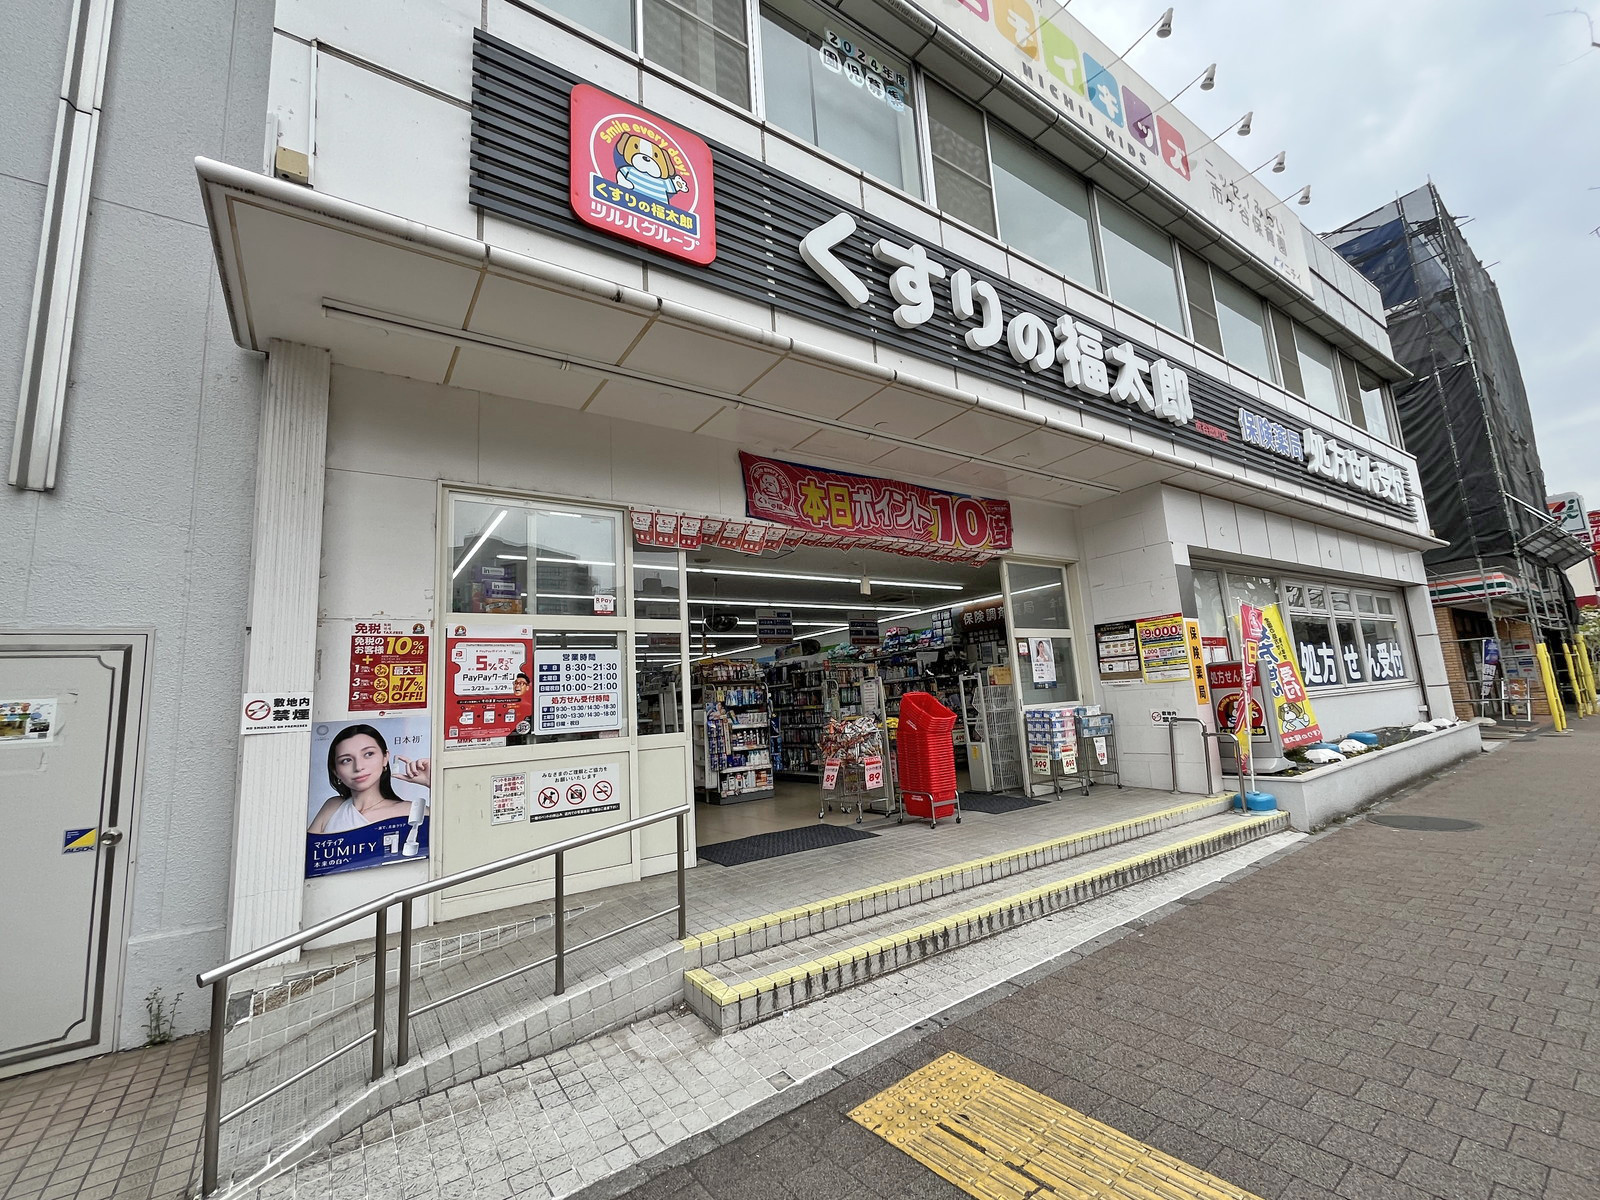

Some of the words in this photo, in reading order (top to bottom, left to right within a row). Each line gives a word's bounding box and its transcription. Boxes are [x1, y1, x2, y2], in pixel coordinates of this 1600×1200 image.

[952, 0, 1189, 178] チイキッズ
[1022, 61, 1096, 128] NICHII
[1105, 124, 1148, 167] KIDS
[600, 120, 631, 144] Smile
[632, 123, 669, 149] every
[668, 147, 691, 177] day!
[596, 183, 693, 230] くすりの福太郎
[590, 201, 701, 251] ツルハグループ
[799, 211, 1194, 427] くすりの福太郎
[1238, 407, 1304, 462] 保険薬局
[1303, 427, 1408, 506] 処方せん受付
[355, 622, 381, 634] 免税
[354, 636, 385, 646] 免税の
[354, 645, 385, 655] お客様
[562, 653, 596, 662] 営業時間
[1300, 641, 1404, 685] 処方せん受付
[393, 666, 414, 675] 最大
[462, 672, 515, 682] PayPayクーポン
[391, 691, 423, 702] OFF!!
[551, 694, 610, 705] 処方せん受付時間
[273, 697, 310, 708] 敷地内
[273, 709, 310, 721] 禁煙
[394, 736, 420, 745] 日本初
[314, 838, 345, 848] マイティア
[63, 846, 95, 854] ALSOK
[313, 841, 377, 861] LUMIFY
[313, 858, 350, 868] 本来の白へ
